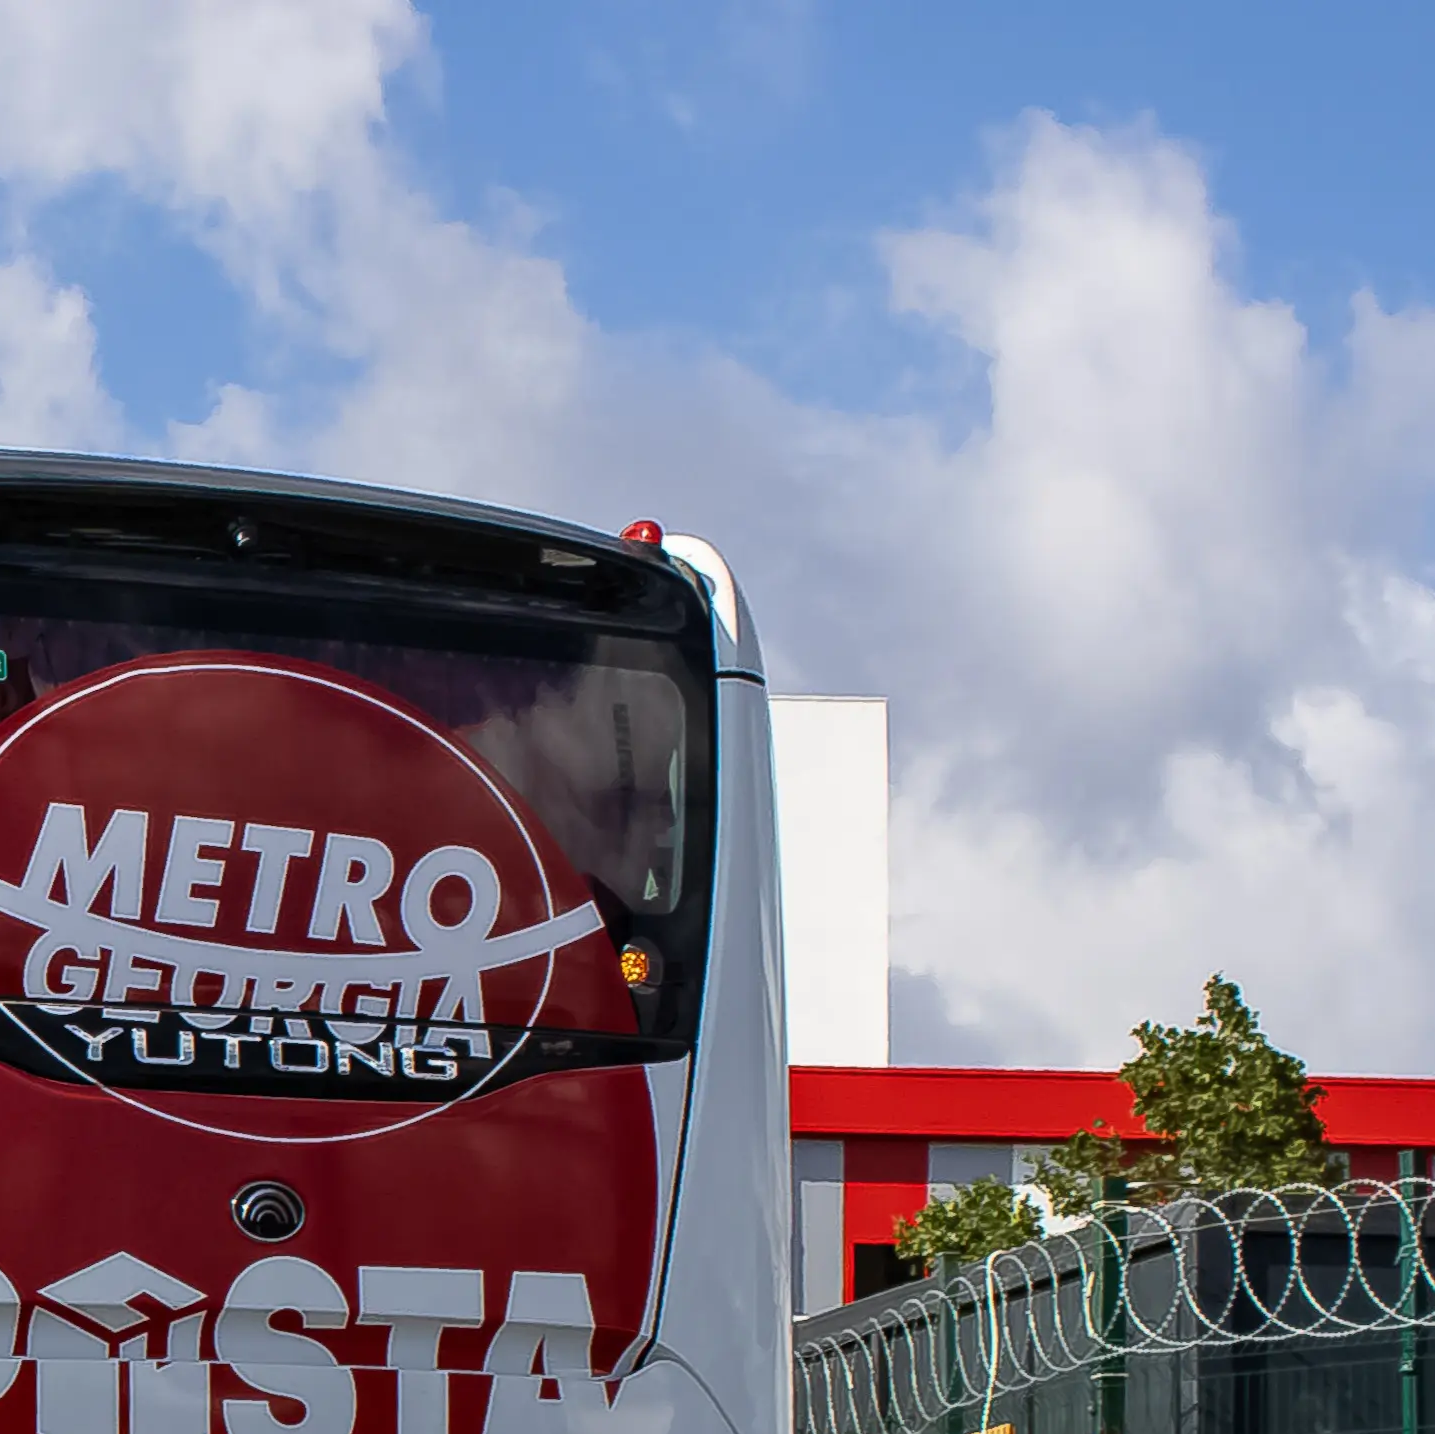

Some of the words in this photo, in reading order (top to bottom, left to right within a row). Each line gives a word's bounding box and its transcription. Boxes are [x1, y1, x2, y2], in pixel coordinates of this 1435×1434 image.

[21, 802, 501, 952] METRO
[23, 927, 493, 1059] GEORGIA
[64, 1024, 459, 1081] YUTONG
